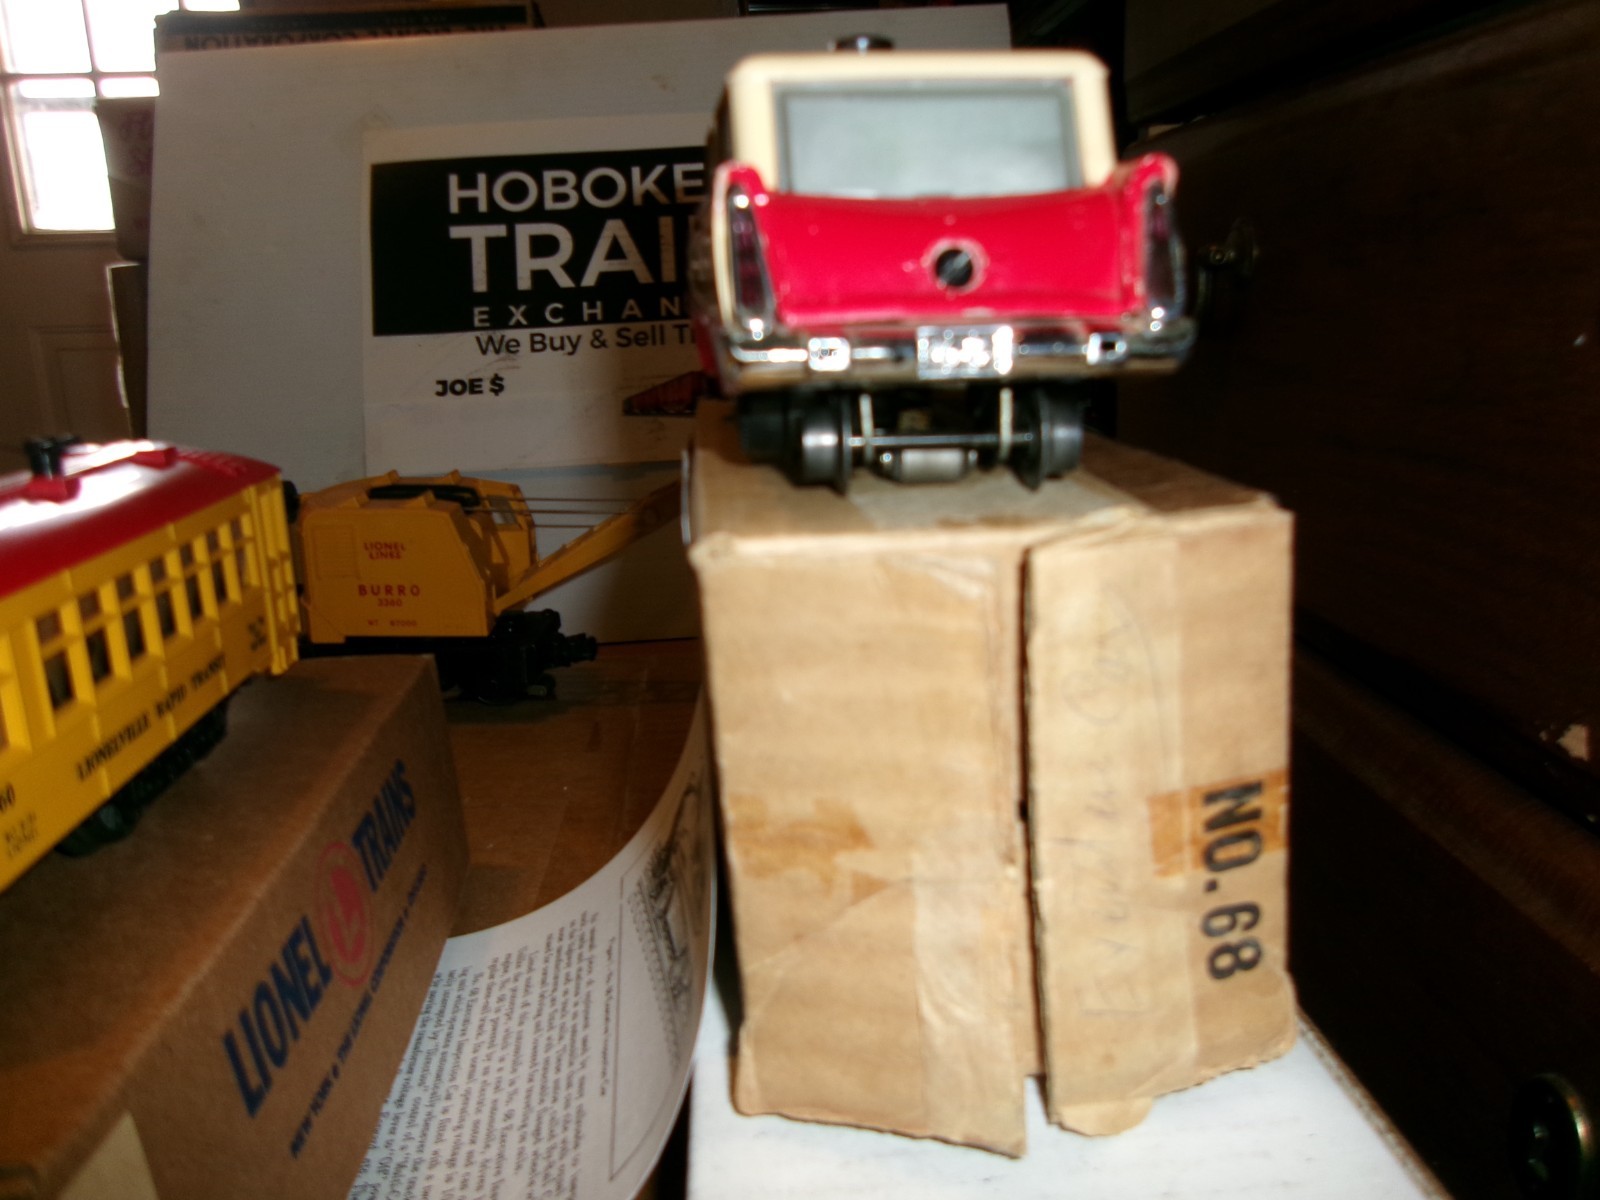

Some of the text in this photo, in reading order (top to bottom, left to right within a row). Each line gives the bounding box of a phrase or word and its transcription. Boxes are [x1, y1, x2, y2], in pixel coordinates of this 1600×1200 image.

[449, 163, 704, 214] HOBOKE
[449, 215, 697, 293] TRAI
[473, 296, 681, 328] EXCHAN
[475, 335, 521, 356] We
[530, 332, 582, 356] Buy
[590, 329, 608, 350] &
[616, 324, 665, 348] Sell
[435, 373, 505, 398] JOE $
[363, 541, 406, 551] LIONEL
[357, 584, 421, 597] BURRO
[1202, 779, 1264, 981] NO. 68
[222, 914, 333, 1120] LIONEL
[351, 759, 417, 894] TRAINS
